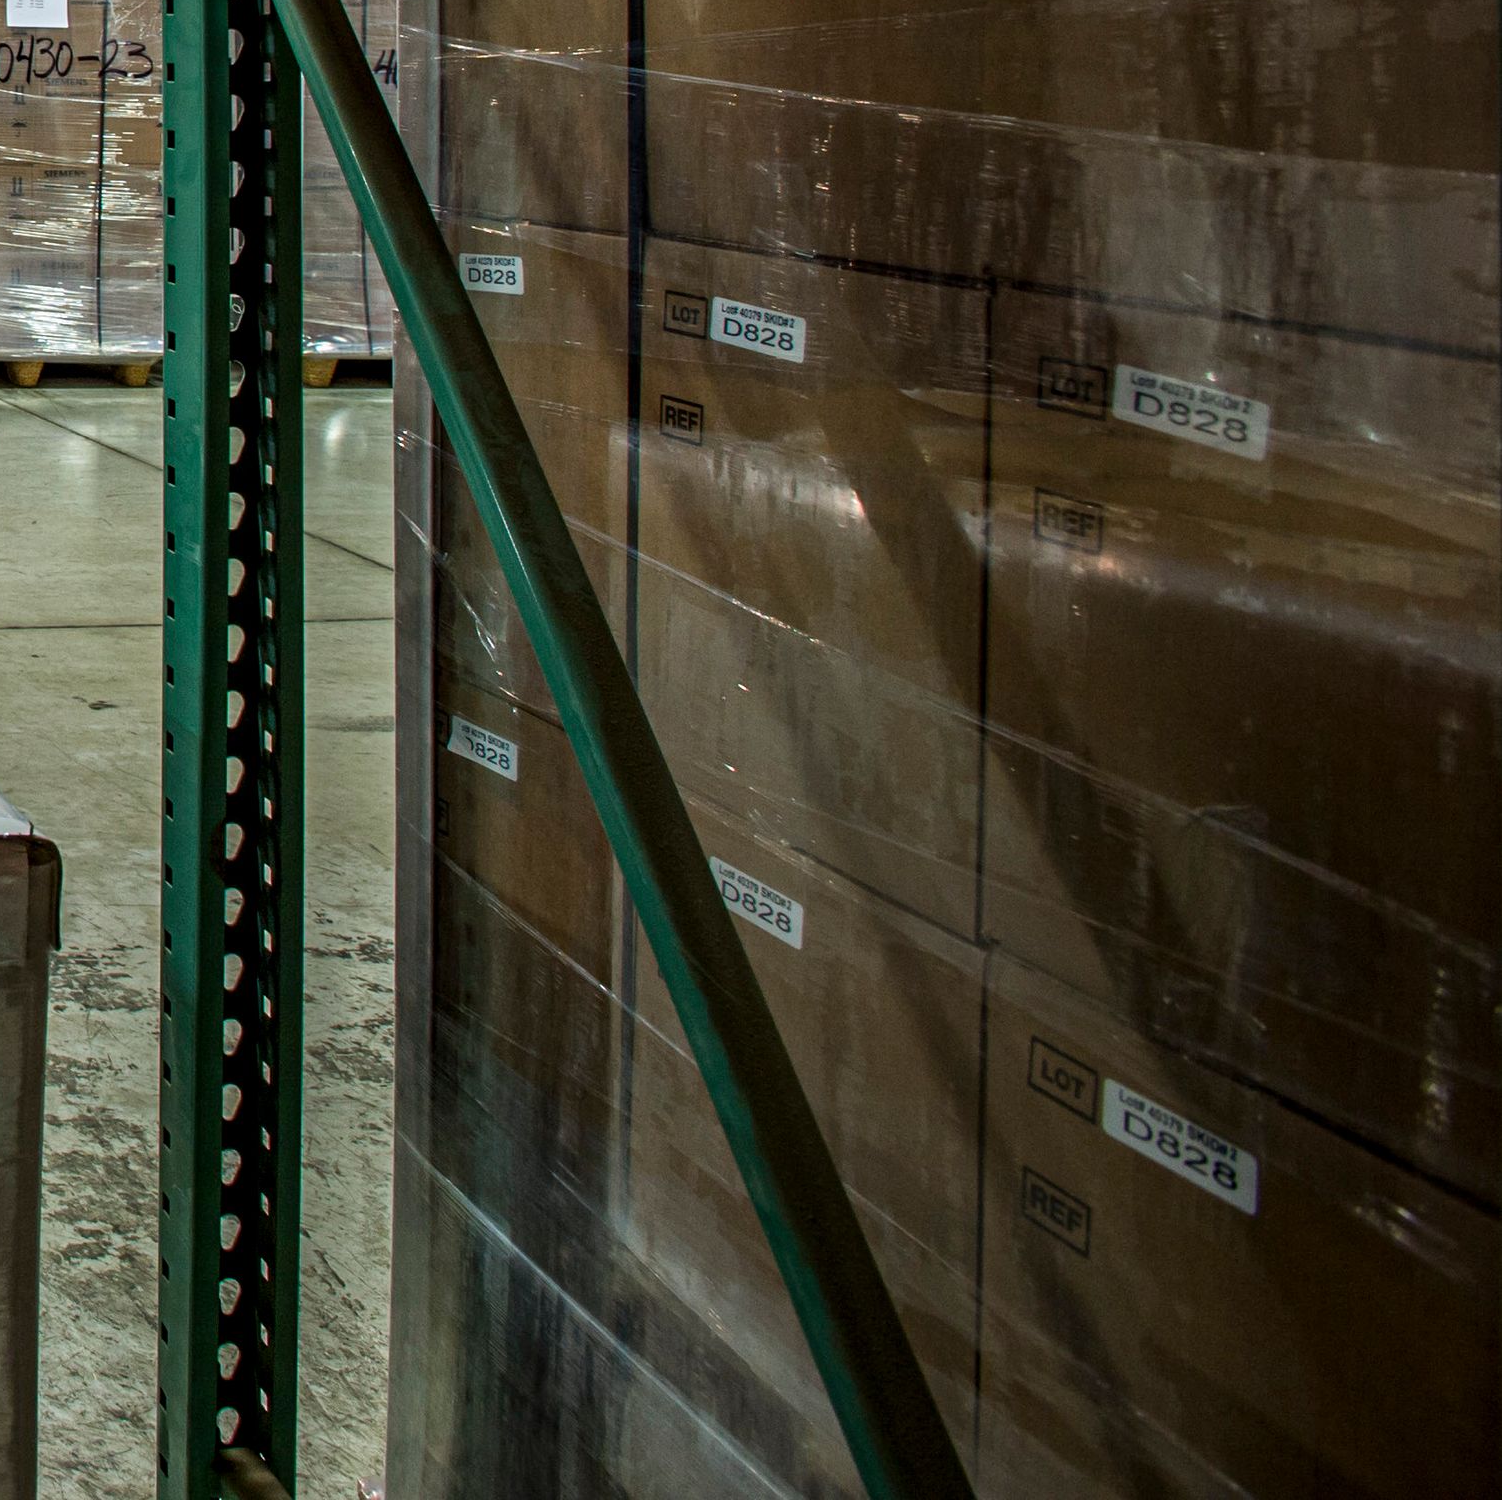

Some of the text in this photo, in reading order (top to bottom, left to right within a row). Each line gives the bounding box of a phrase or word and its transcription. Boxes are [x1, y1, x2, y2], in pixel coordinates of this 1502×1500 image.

[44, 169, 87, 178] SIEMENS
[468, 267, 517, 285] D828
[672, 304, 700, 325] LOT
[721, 303, 739, 315] Lot#
[723, 317, 794, 351] D828
[1050, 372, 1094, 402] LOT
[664, 405, 699, 432] REF
[1133, 391, 1247, 442] D828
[1042, 502, 1096, 538] REF
[722, 879, 792, 933] D828
[1041, 1058, 1085, 1099] LOT
[1123, 1109, 1238, 1192] D828
[1030, 1183, 1083, 1232] REF
